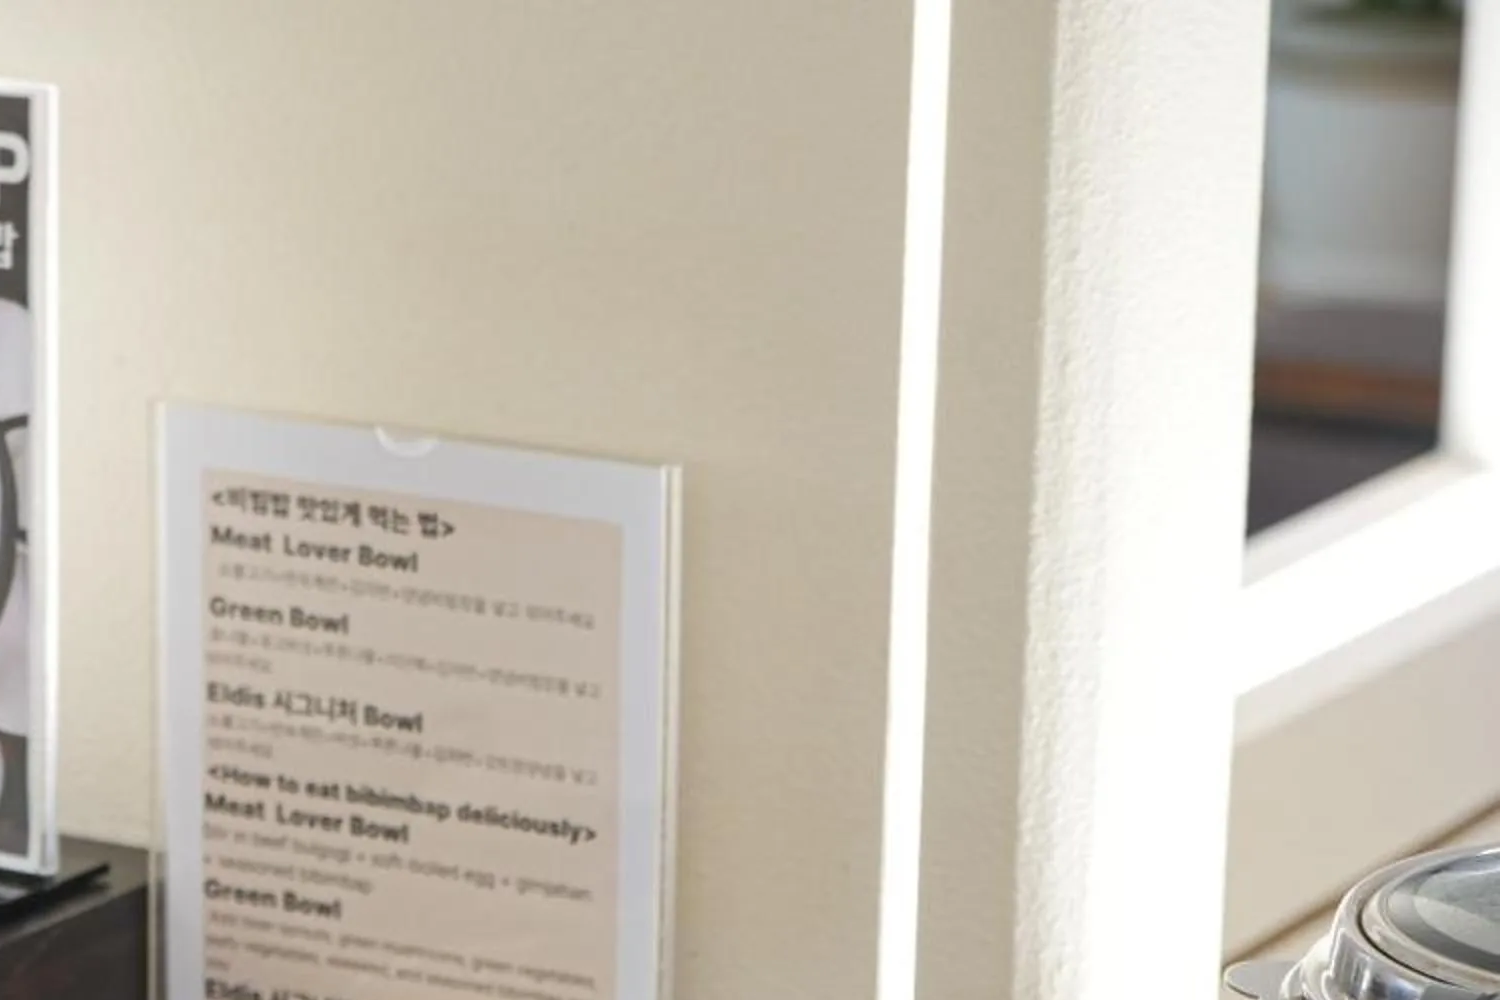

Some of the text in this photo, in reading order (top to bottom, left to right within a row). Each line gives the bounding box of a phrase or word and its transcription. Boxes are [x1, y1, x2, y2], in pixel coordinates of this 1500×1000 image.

[210, 525, 419, 573] Meat Lover Bowl
[209, 596, 350, 635] Green Bowl
[207, 681, 424, 734] Eldis 시그니처 Bowl
[204, 793, 266, 821] Meat
[276, 804, 343, 834] Lover
[350, 813, 410, 843] Bowl
[277, 771, 300, 795] to
[305, 780, 340, 801] eat
[345, 784, 452, 822] bibimbap
[204, 878, 343, 920] Green Bowl
